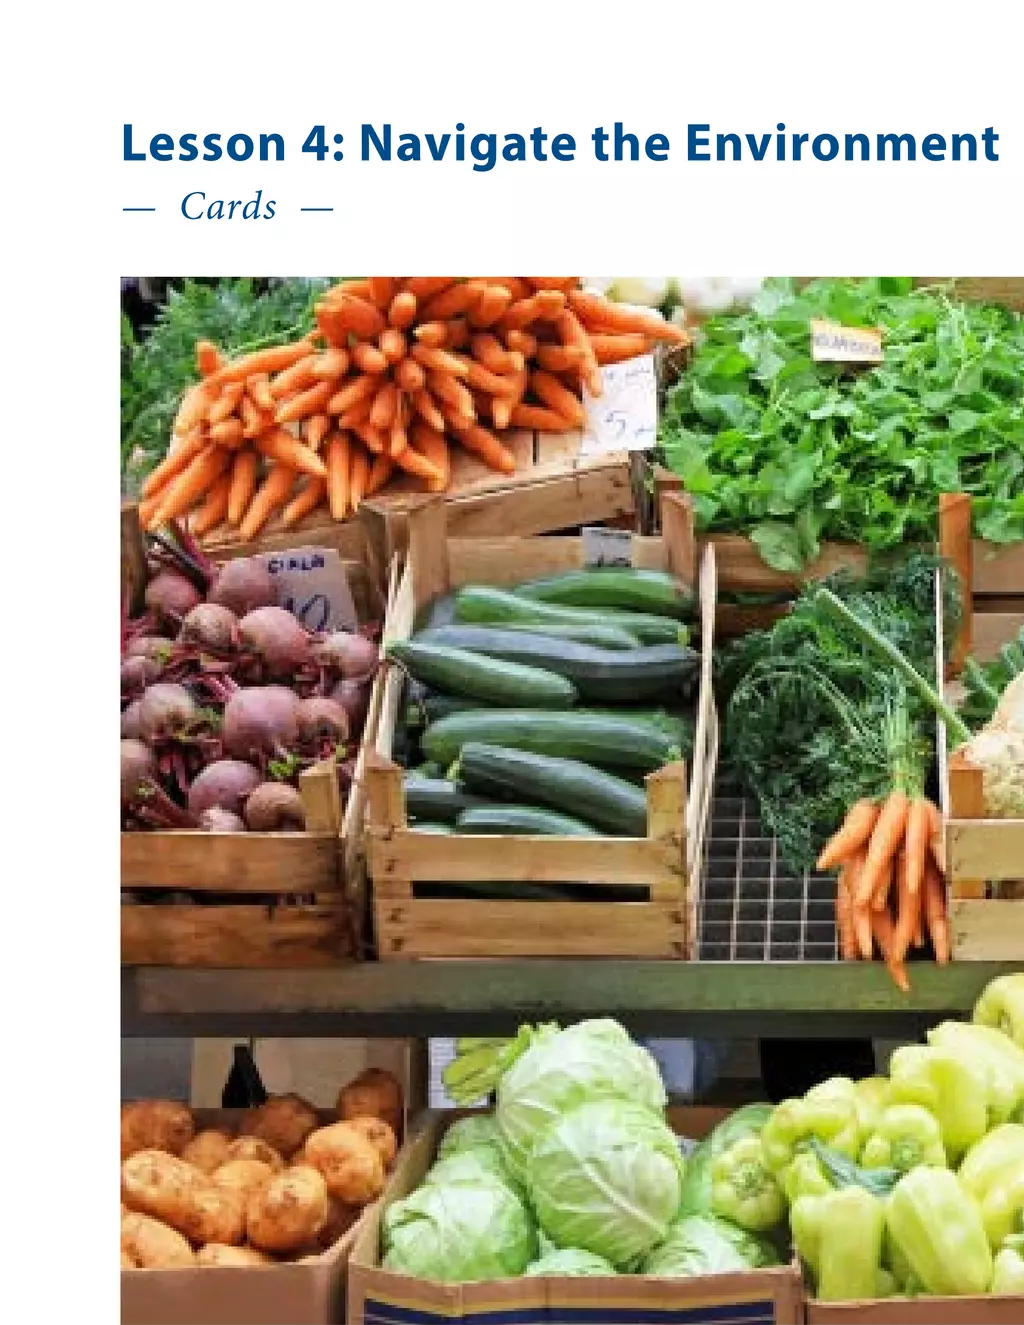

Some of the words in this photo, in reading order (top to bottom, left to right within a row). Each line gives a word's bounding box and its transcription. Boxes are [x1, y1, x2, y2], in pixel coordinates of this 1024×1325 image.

[124, 124, 284, 161] Lesson
[302, 126, 343, 161] 4:
[362, 123, 576, 172] Navigate
[592, 122, 669, 161] the
[688, 123, 999, 161] Environment
[181, 190, 276, 219] Cards
